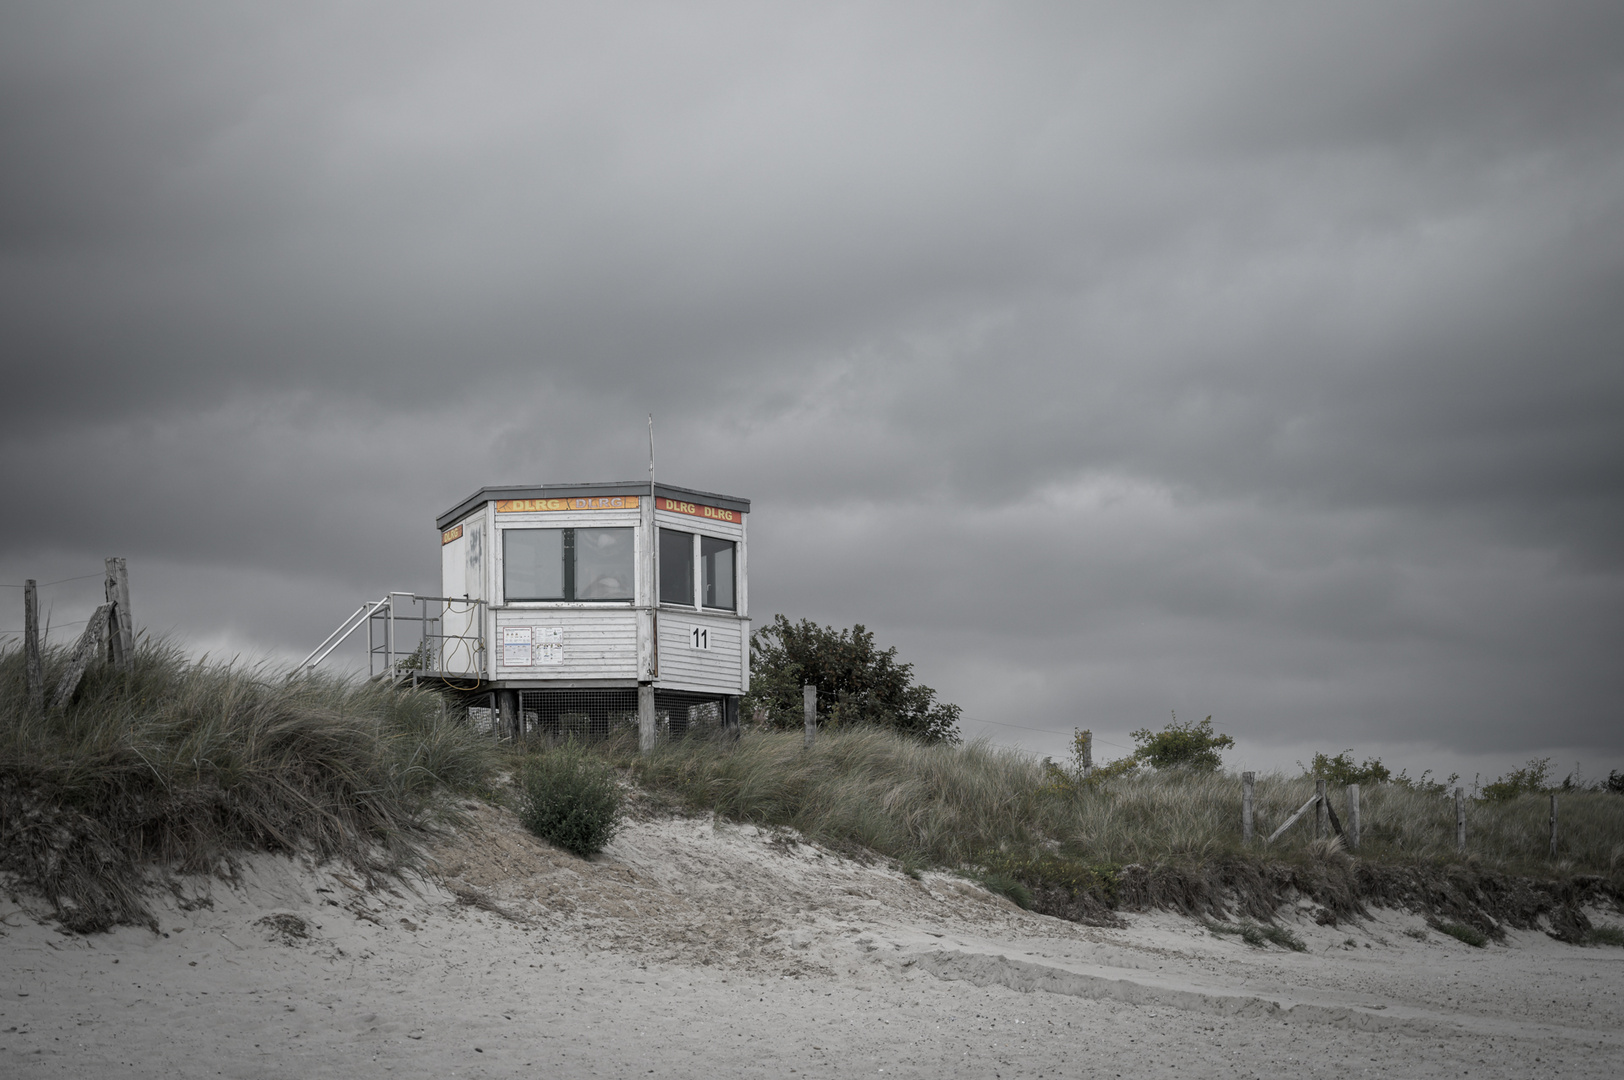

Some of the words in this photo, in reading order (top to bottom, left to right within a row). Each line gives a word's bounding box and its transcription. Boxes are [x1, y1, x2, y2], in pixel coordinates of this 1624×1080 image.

[513, 499, 560, 510] DLRG
[576, 498, 623, 508] DLRG
[666, 500, 695, 513] DLRG
[705, 507, 732, 520] DLRG
[444, 528, 459, 543] DLRG
[693, 627, 707, 649] 11
